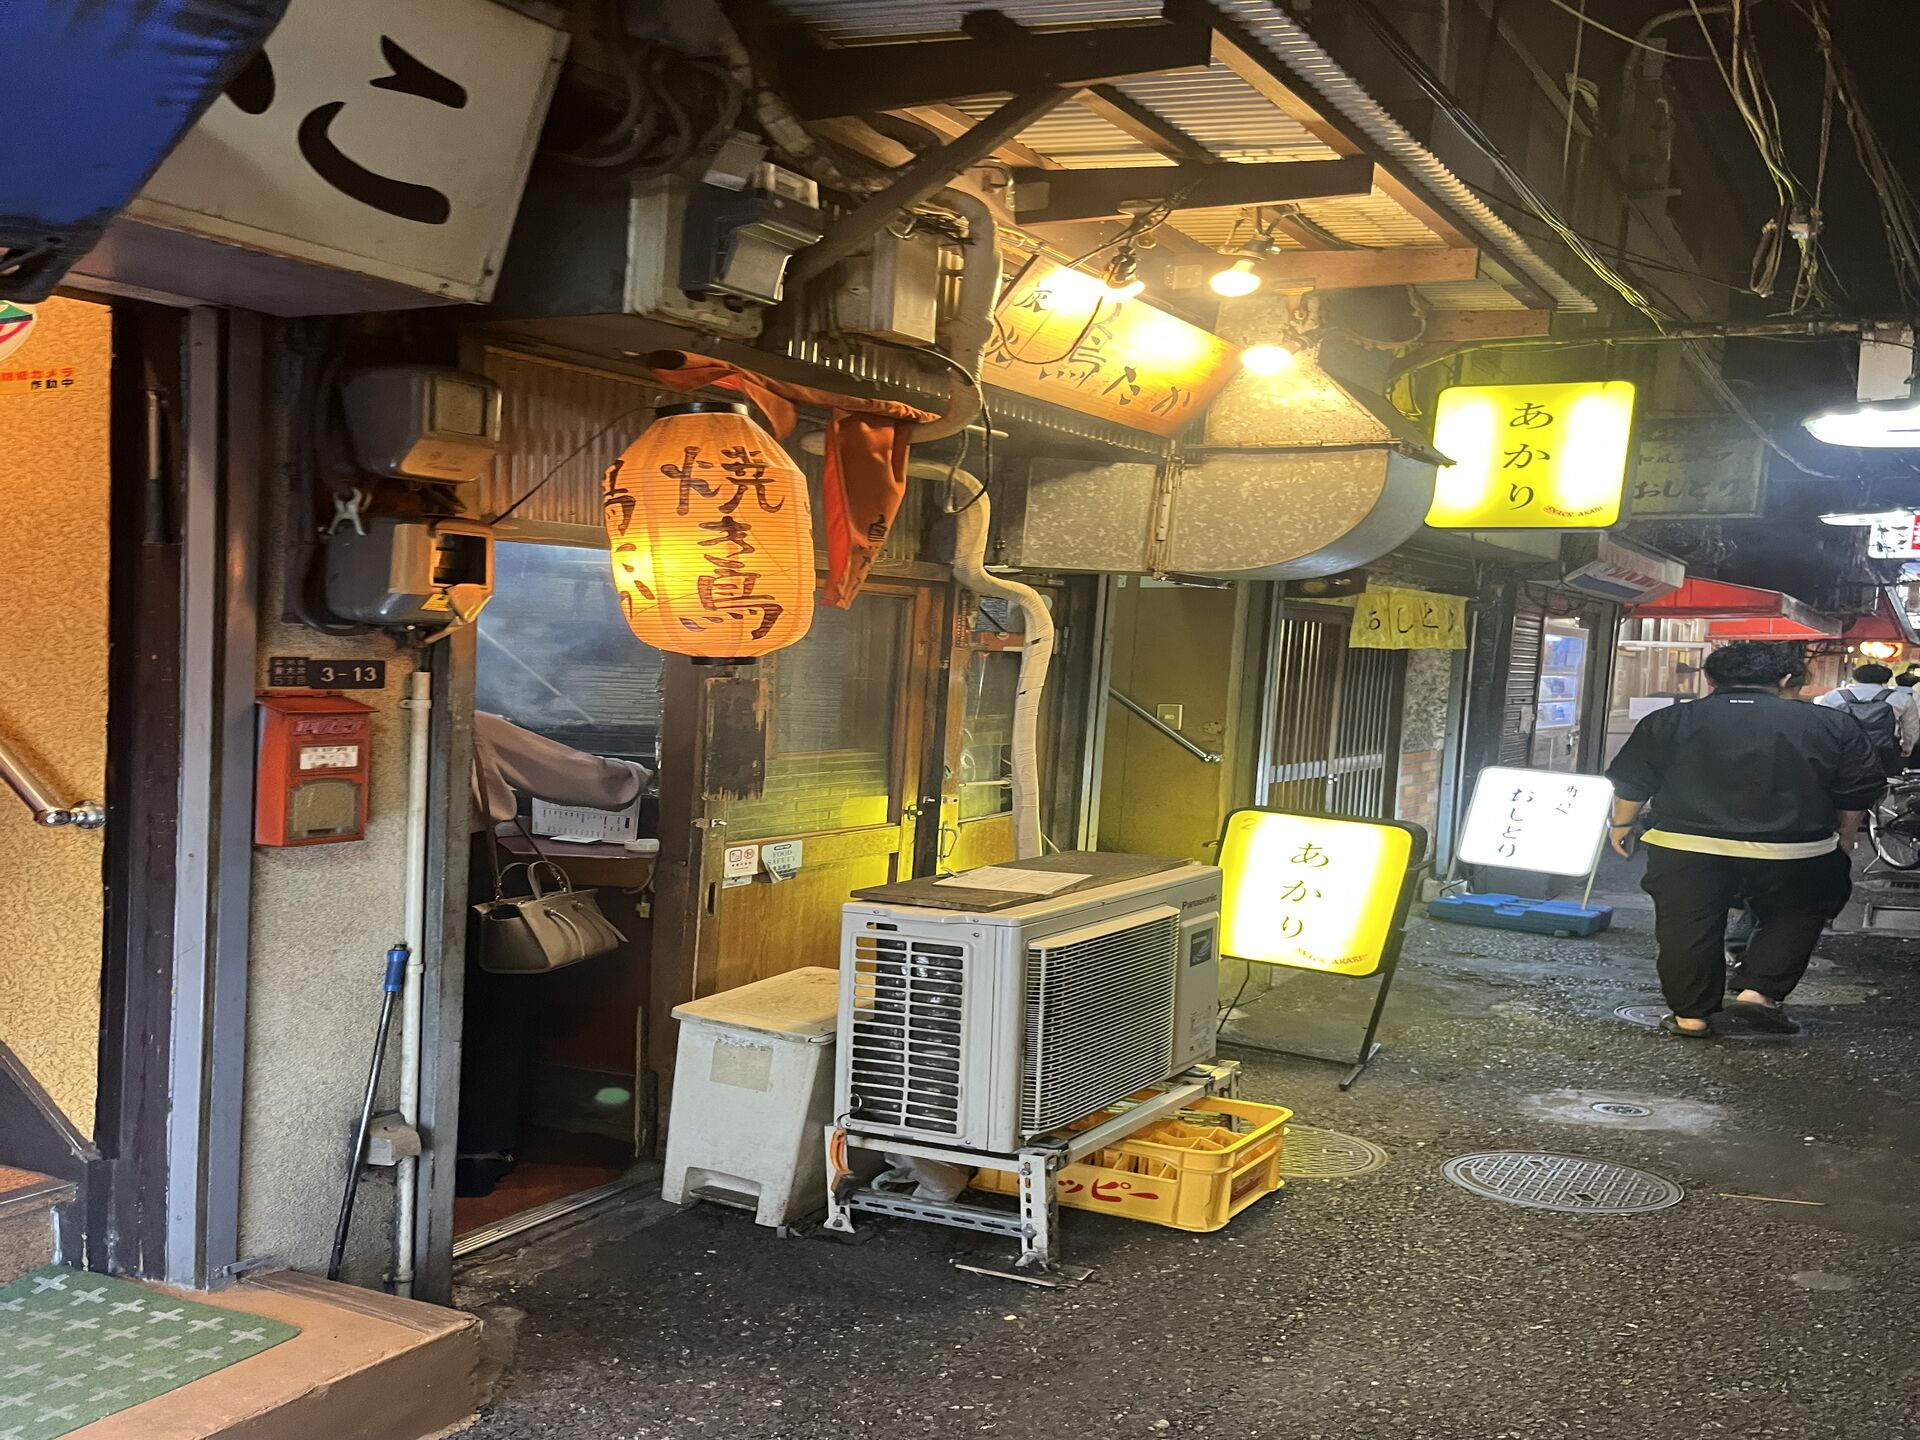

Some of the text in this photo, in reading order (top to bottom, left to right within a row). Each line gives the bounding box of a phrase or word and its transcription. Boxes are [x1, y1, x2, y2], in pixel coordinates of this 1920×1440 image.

[1503, 401, 1554, 511] あかり
[660, 446, 785, 640] 焼き鳥
[320, 667, 378, 683] 3-13
[1182, 895, 1217, 910] Panasonic
[1280, 842, 1329, 939] あかり
